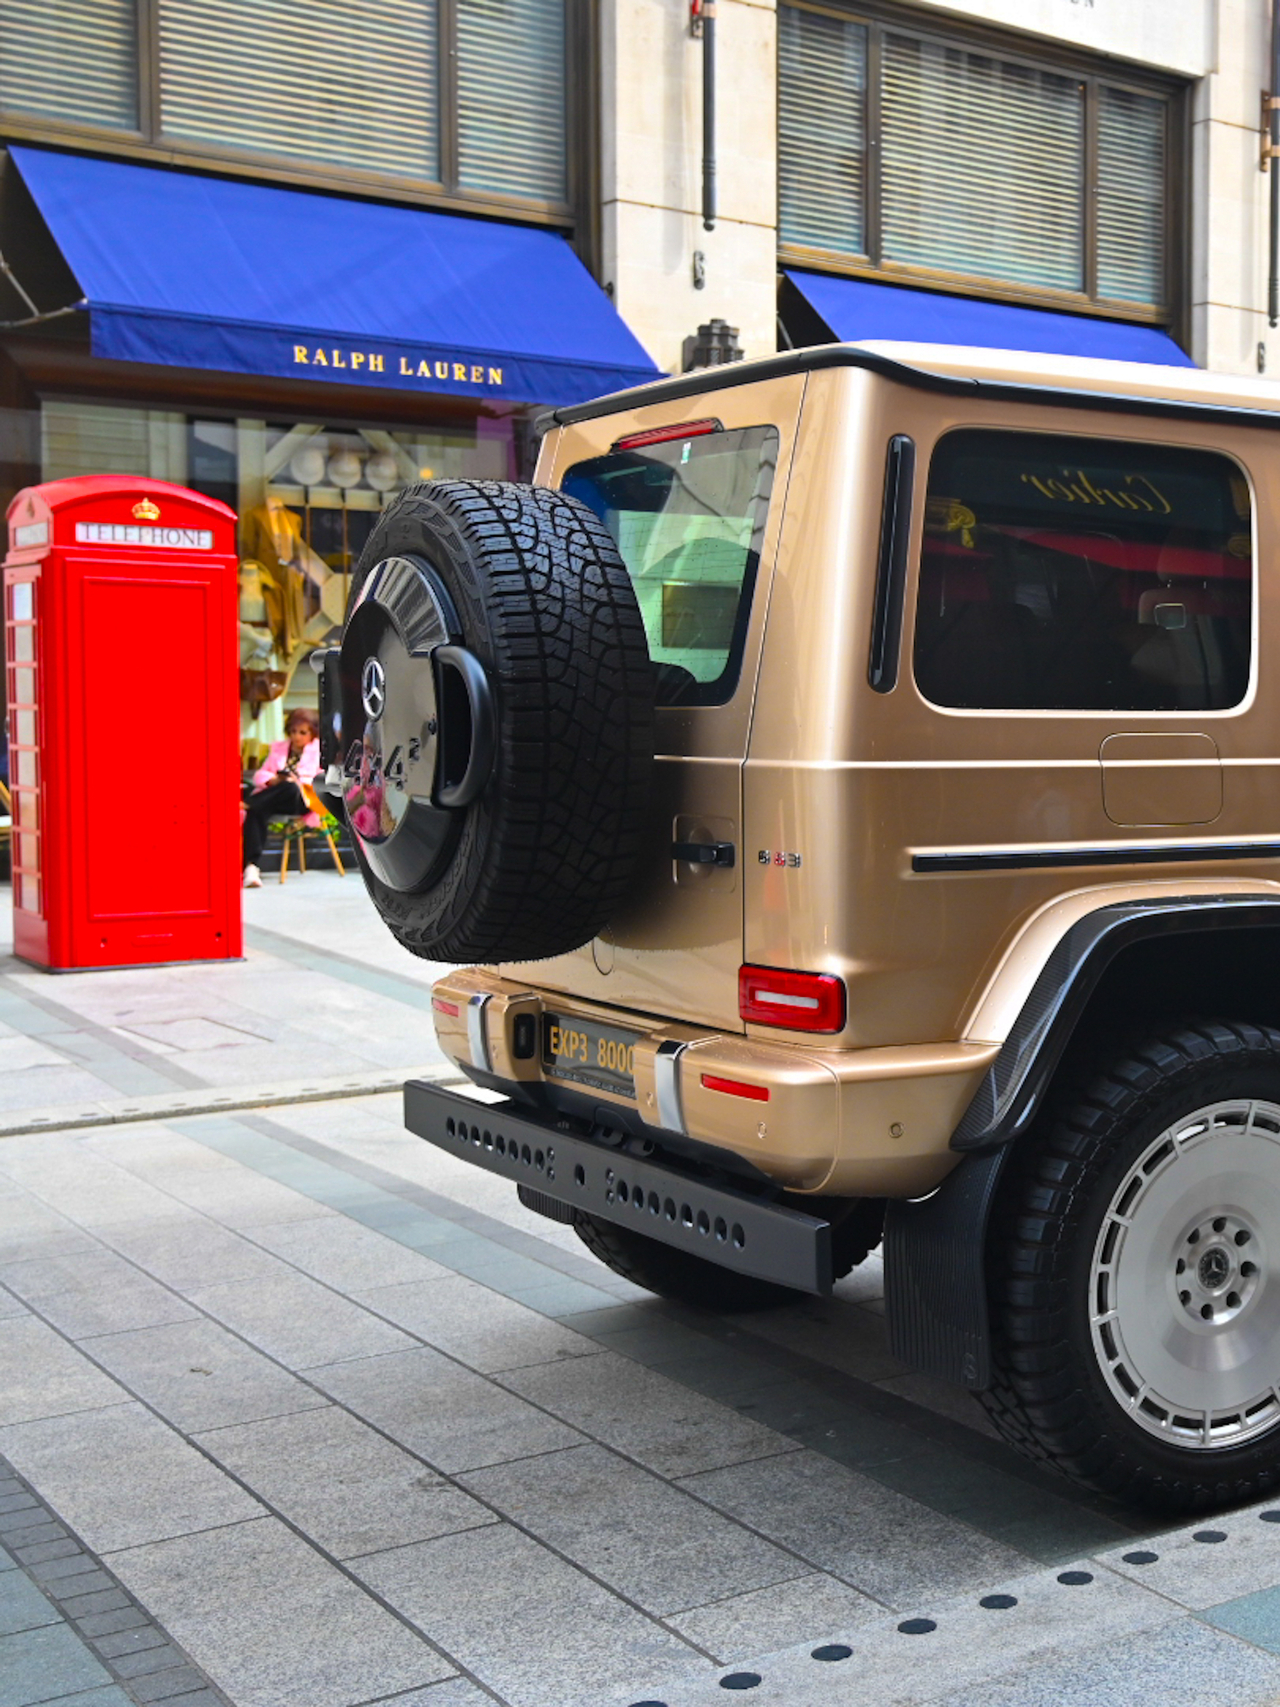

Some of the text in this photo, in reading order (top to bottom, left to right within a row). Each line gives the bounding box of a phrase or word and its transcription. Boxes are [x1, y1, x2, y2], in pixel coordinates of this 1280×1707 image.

[293, 345, 503, 385] RALPH LAUREN
[82, 522, 208, 547] TELEPHONE
[550, 1025, 588, 1062] EXP3
